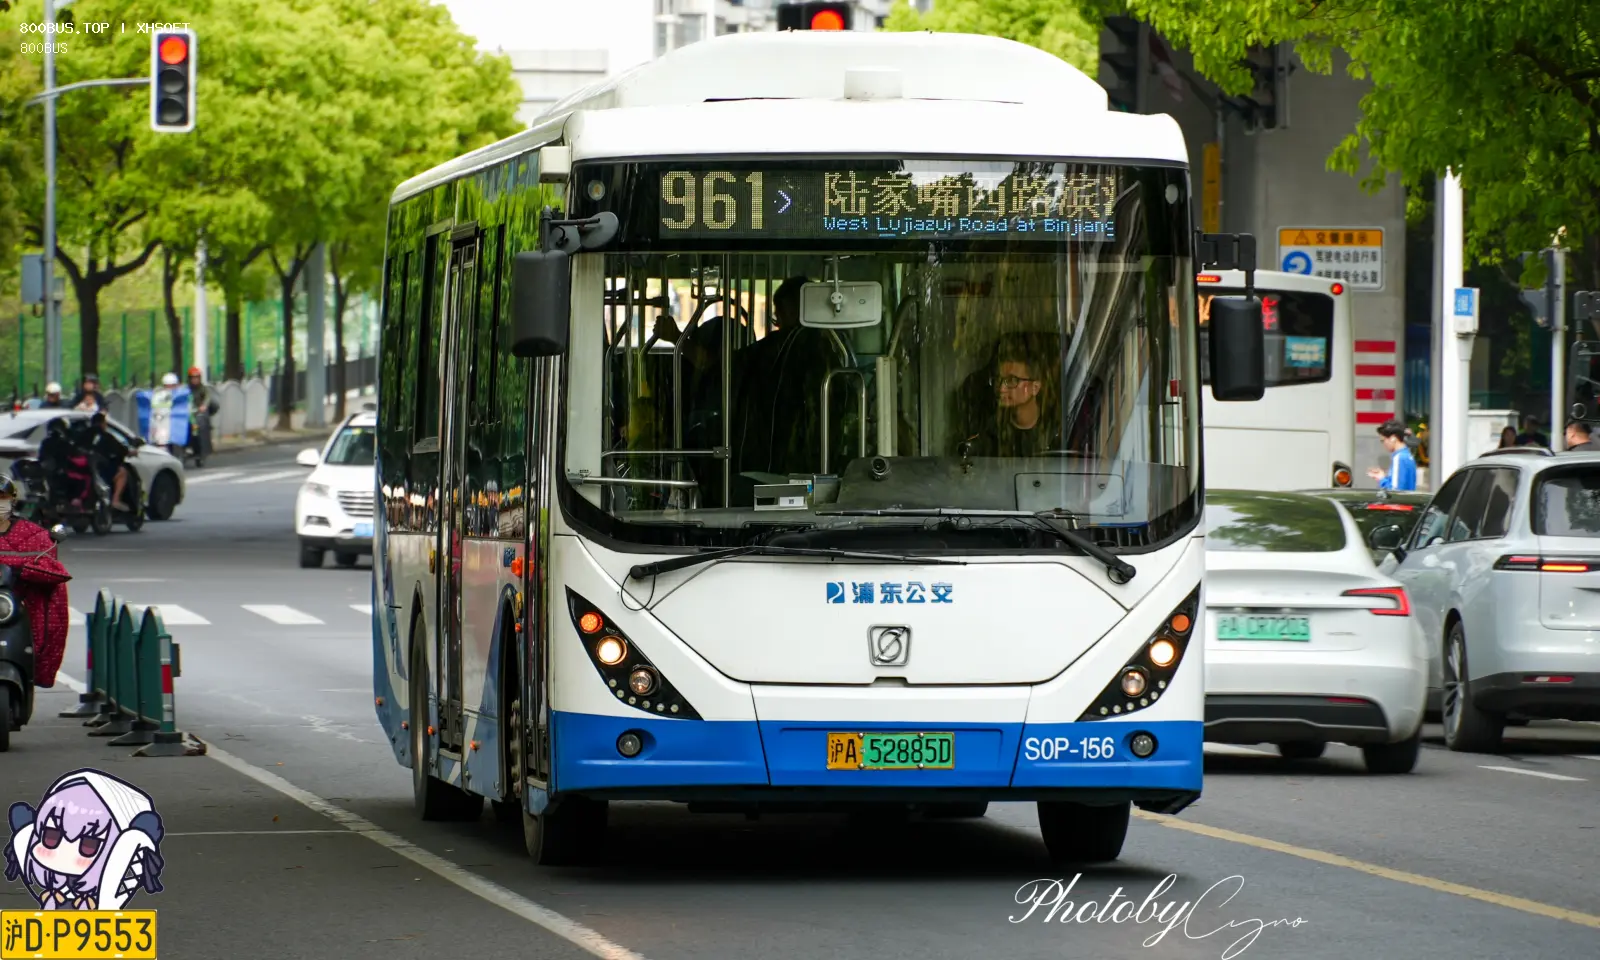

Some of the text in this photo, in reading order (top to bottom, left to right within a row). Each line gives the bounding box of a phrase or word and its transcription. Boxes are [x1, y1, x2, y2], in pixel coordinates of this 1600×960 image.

[662, 171, 763, 230] 961
[823, 216, 1115, 236] West Lujiazui Road at Binjiang
[851, 581, 953, 604] 浦东公交
[869, 738, 951, 763] 52885D
